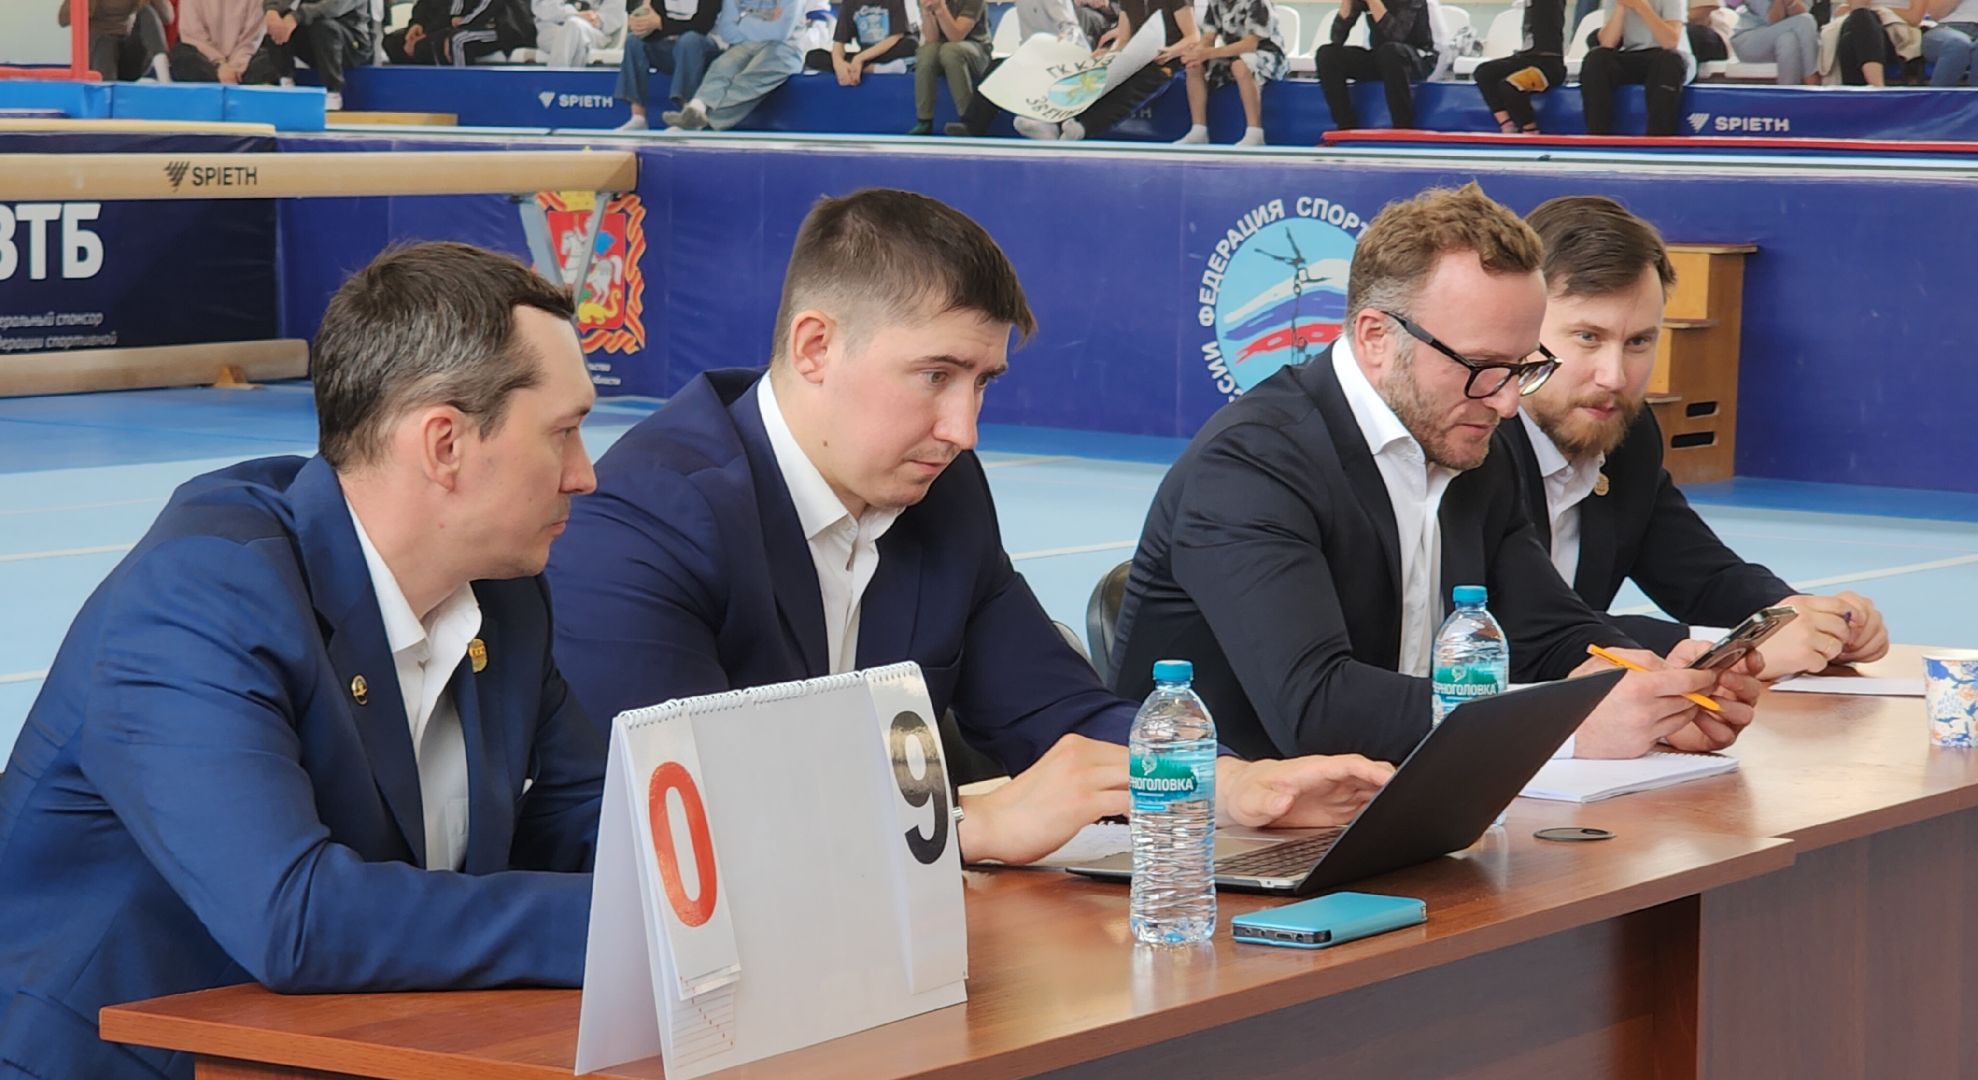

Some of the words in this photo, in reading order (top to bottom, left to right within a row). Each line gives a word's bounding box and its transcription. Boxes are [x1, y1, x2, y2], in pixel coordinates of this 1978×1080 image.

[559, 94, 613, 108] SPIETH
[1714, 116, 1790, 132] SPIETH
[192, 166, 257, 186] SPIETH
[0, 203, 104, 281] ВТБ
[1198, 198, 1285, 327] ФЕДЕРАЦИЯ
[889, 711, 949, 865] 9
[648, 761, 718, 928] 0
